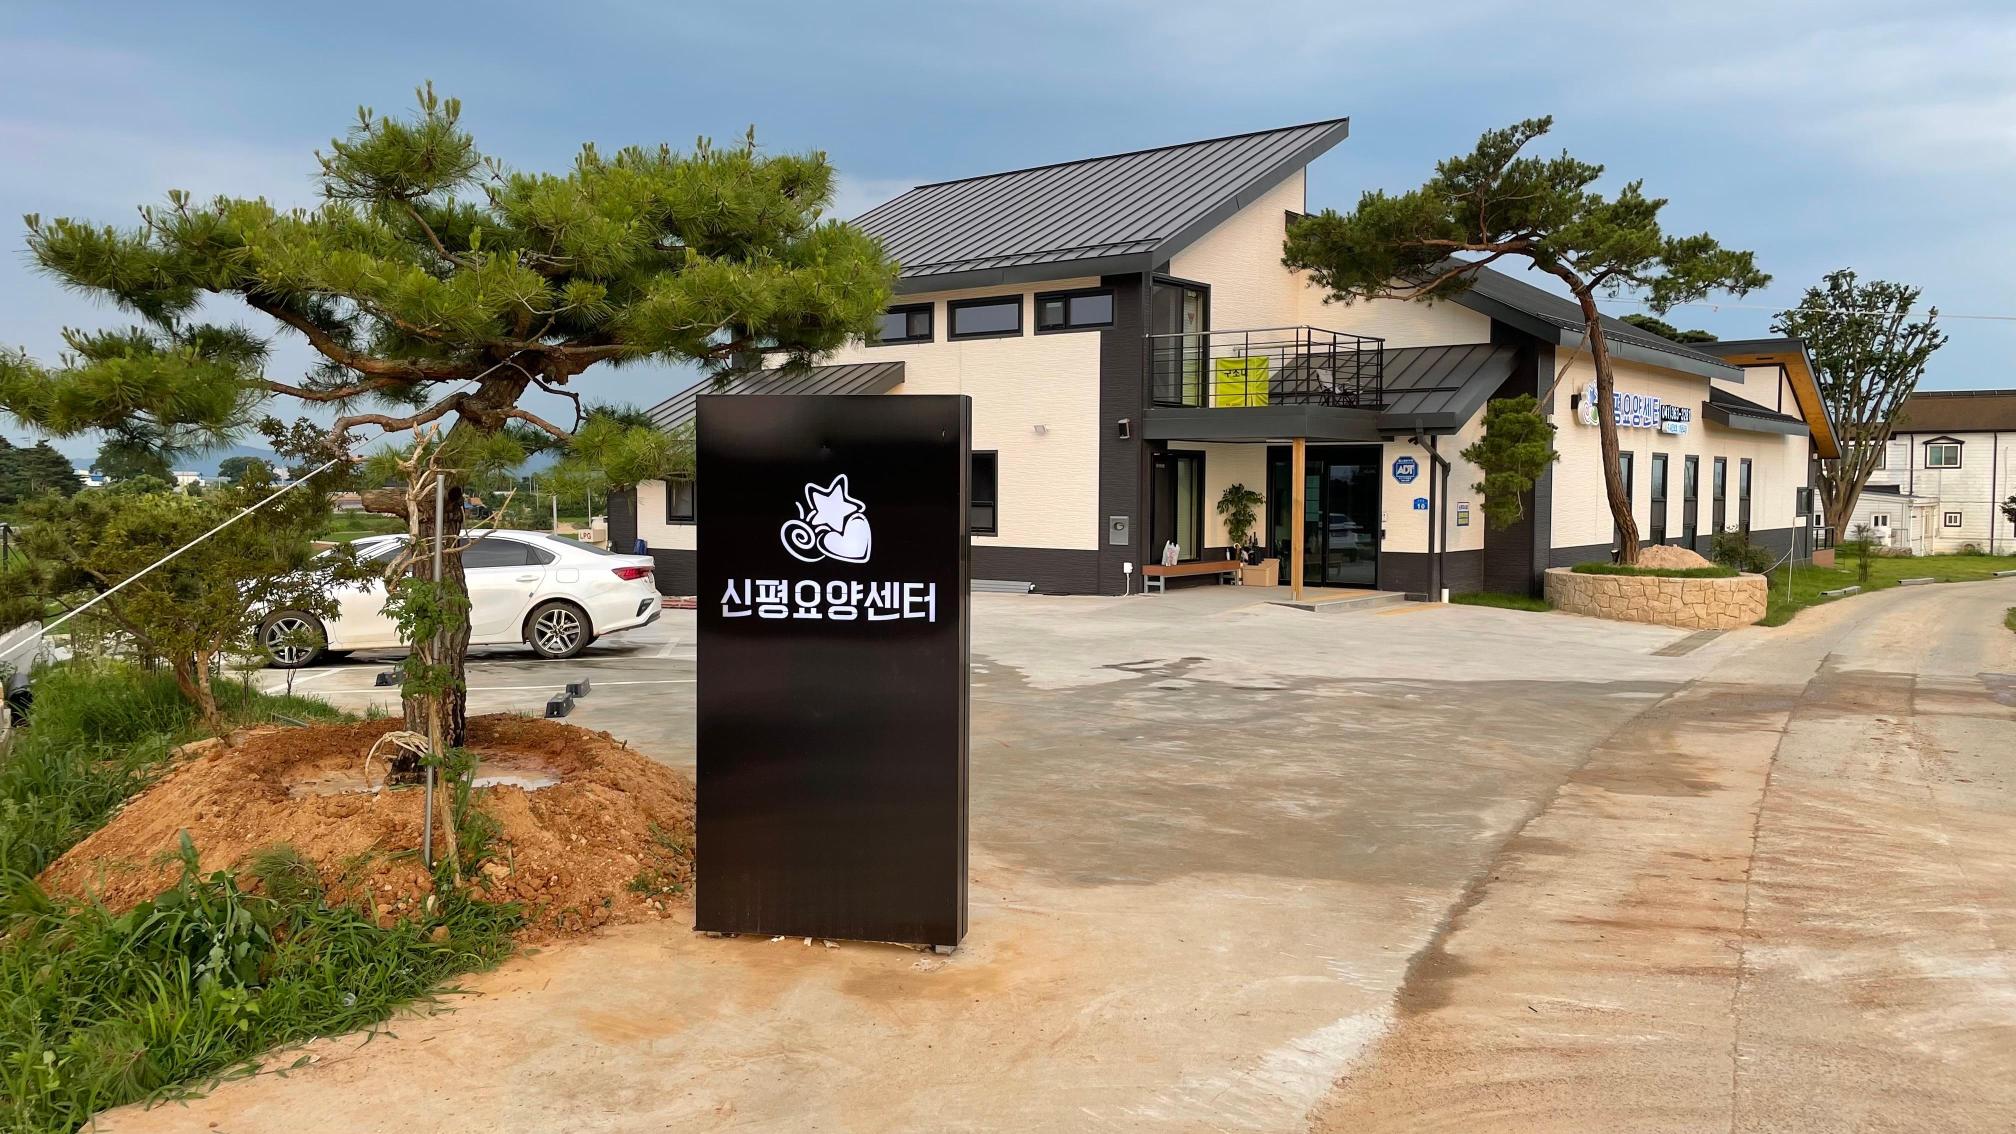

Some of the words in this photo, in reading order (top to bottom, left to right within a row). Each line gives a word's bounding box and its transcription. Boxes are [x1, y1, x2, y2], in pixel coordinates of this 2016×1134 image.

[1613, 393, 1661, 426] 평요양센터
[1396, 464, 1414, 475] ADT
[580, 532, 592, 540] LPG
[720, 578, 936, 622] 신평요양센터
